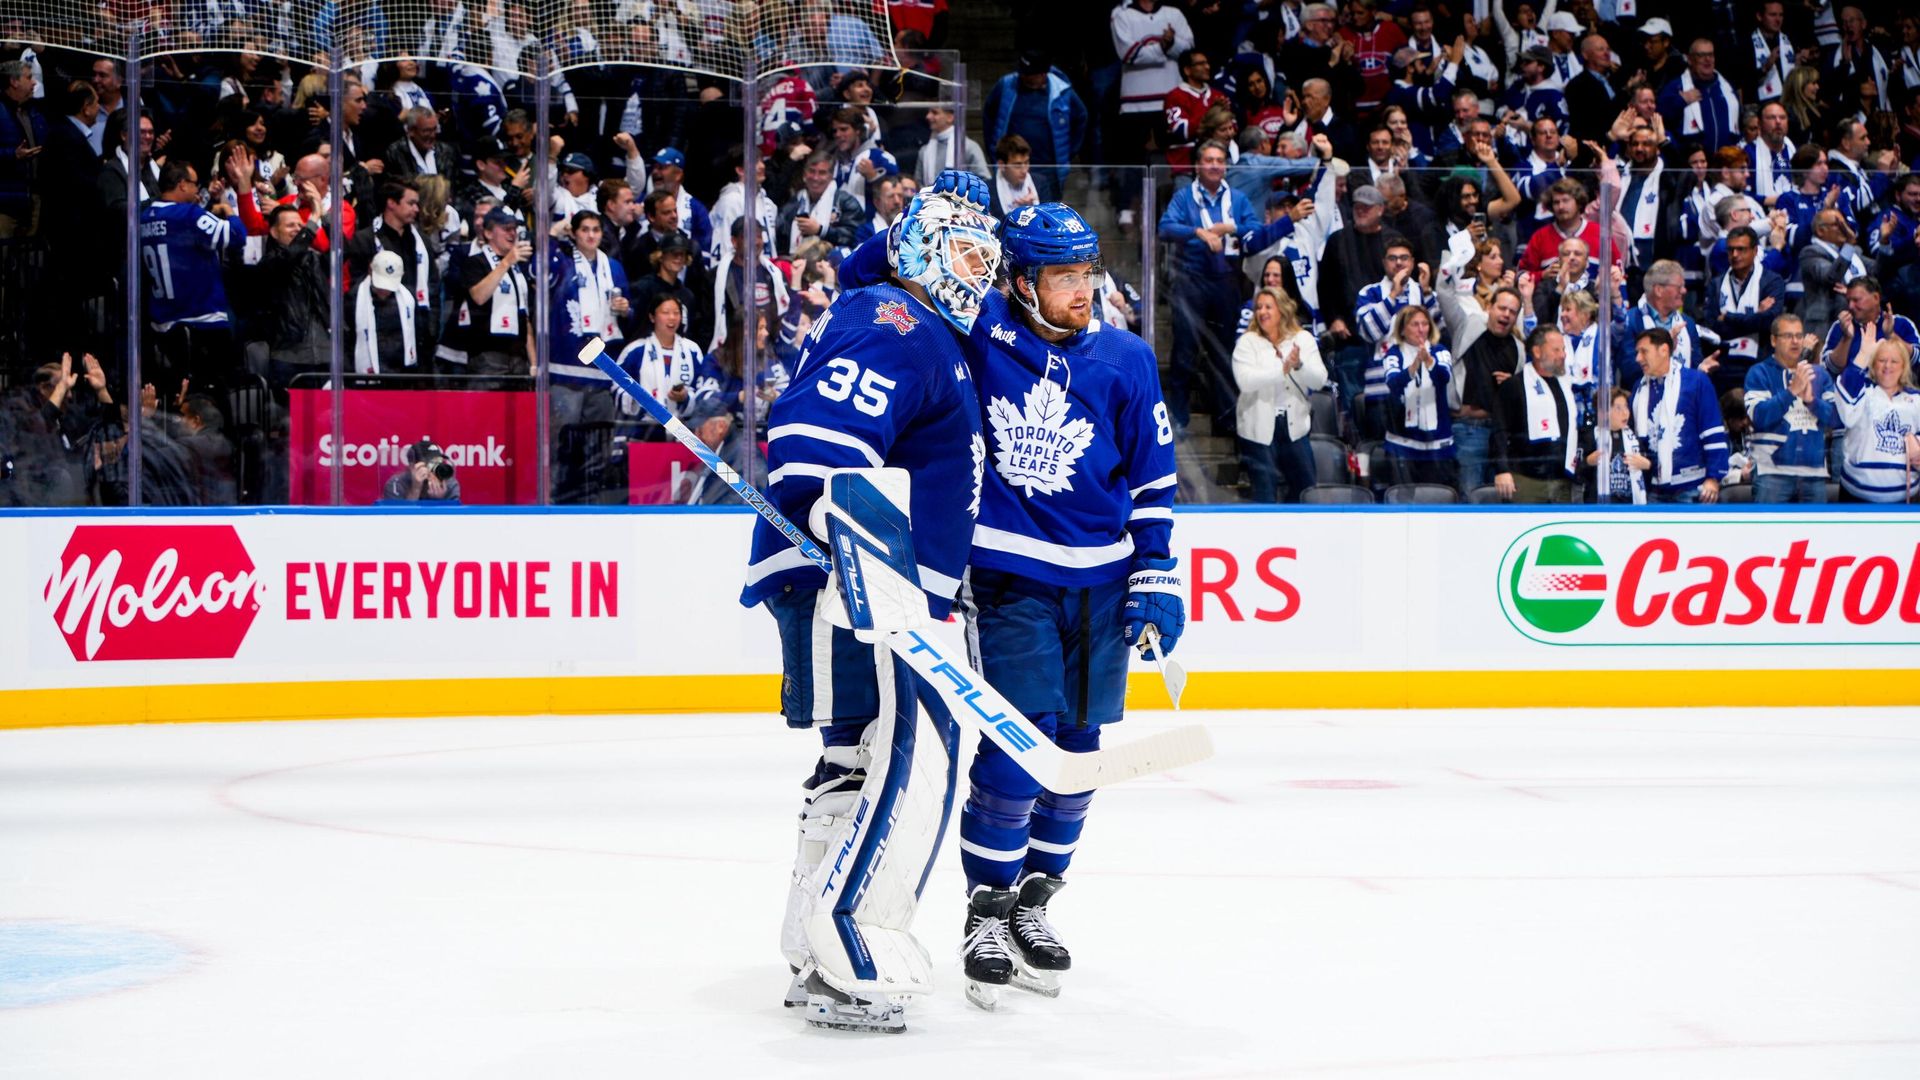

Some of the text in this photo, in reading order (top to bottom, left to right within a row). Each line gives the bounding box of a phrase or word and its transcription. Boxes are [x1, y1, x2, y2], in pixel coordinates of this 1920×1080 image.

[1064, 219, 1085, 234] 88
[143, 243, 175, 299] 91
[990, 322, 1017, 347] Milk
[816, 357, 897, 418] 35
[318, 434, 506, 467] Scotiank
[1004, 426, 1075, 454] TORONTO
[1013, 440, 1062, 462] MAPLE
[1152, 400, 1173, 446] 8
[1009, 454, 1058, 475] LEAFS
[740, 485, 832, 567] HZRDUS PX
[285, 561, 619, 620] EVERYONE IN
[839, 534, 865, 613] TRUE
[1190, 546, 1301, 622] RS
[44, 547, 267, 661] Molson
[905, 630, 1038, 753] TRUE
[821, 796, 870, 900] TRUE
[852, 786, 907, 907] TRUE
